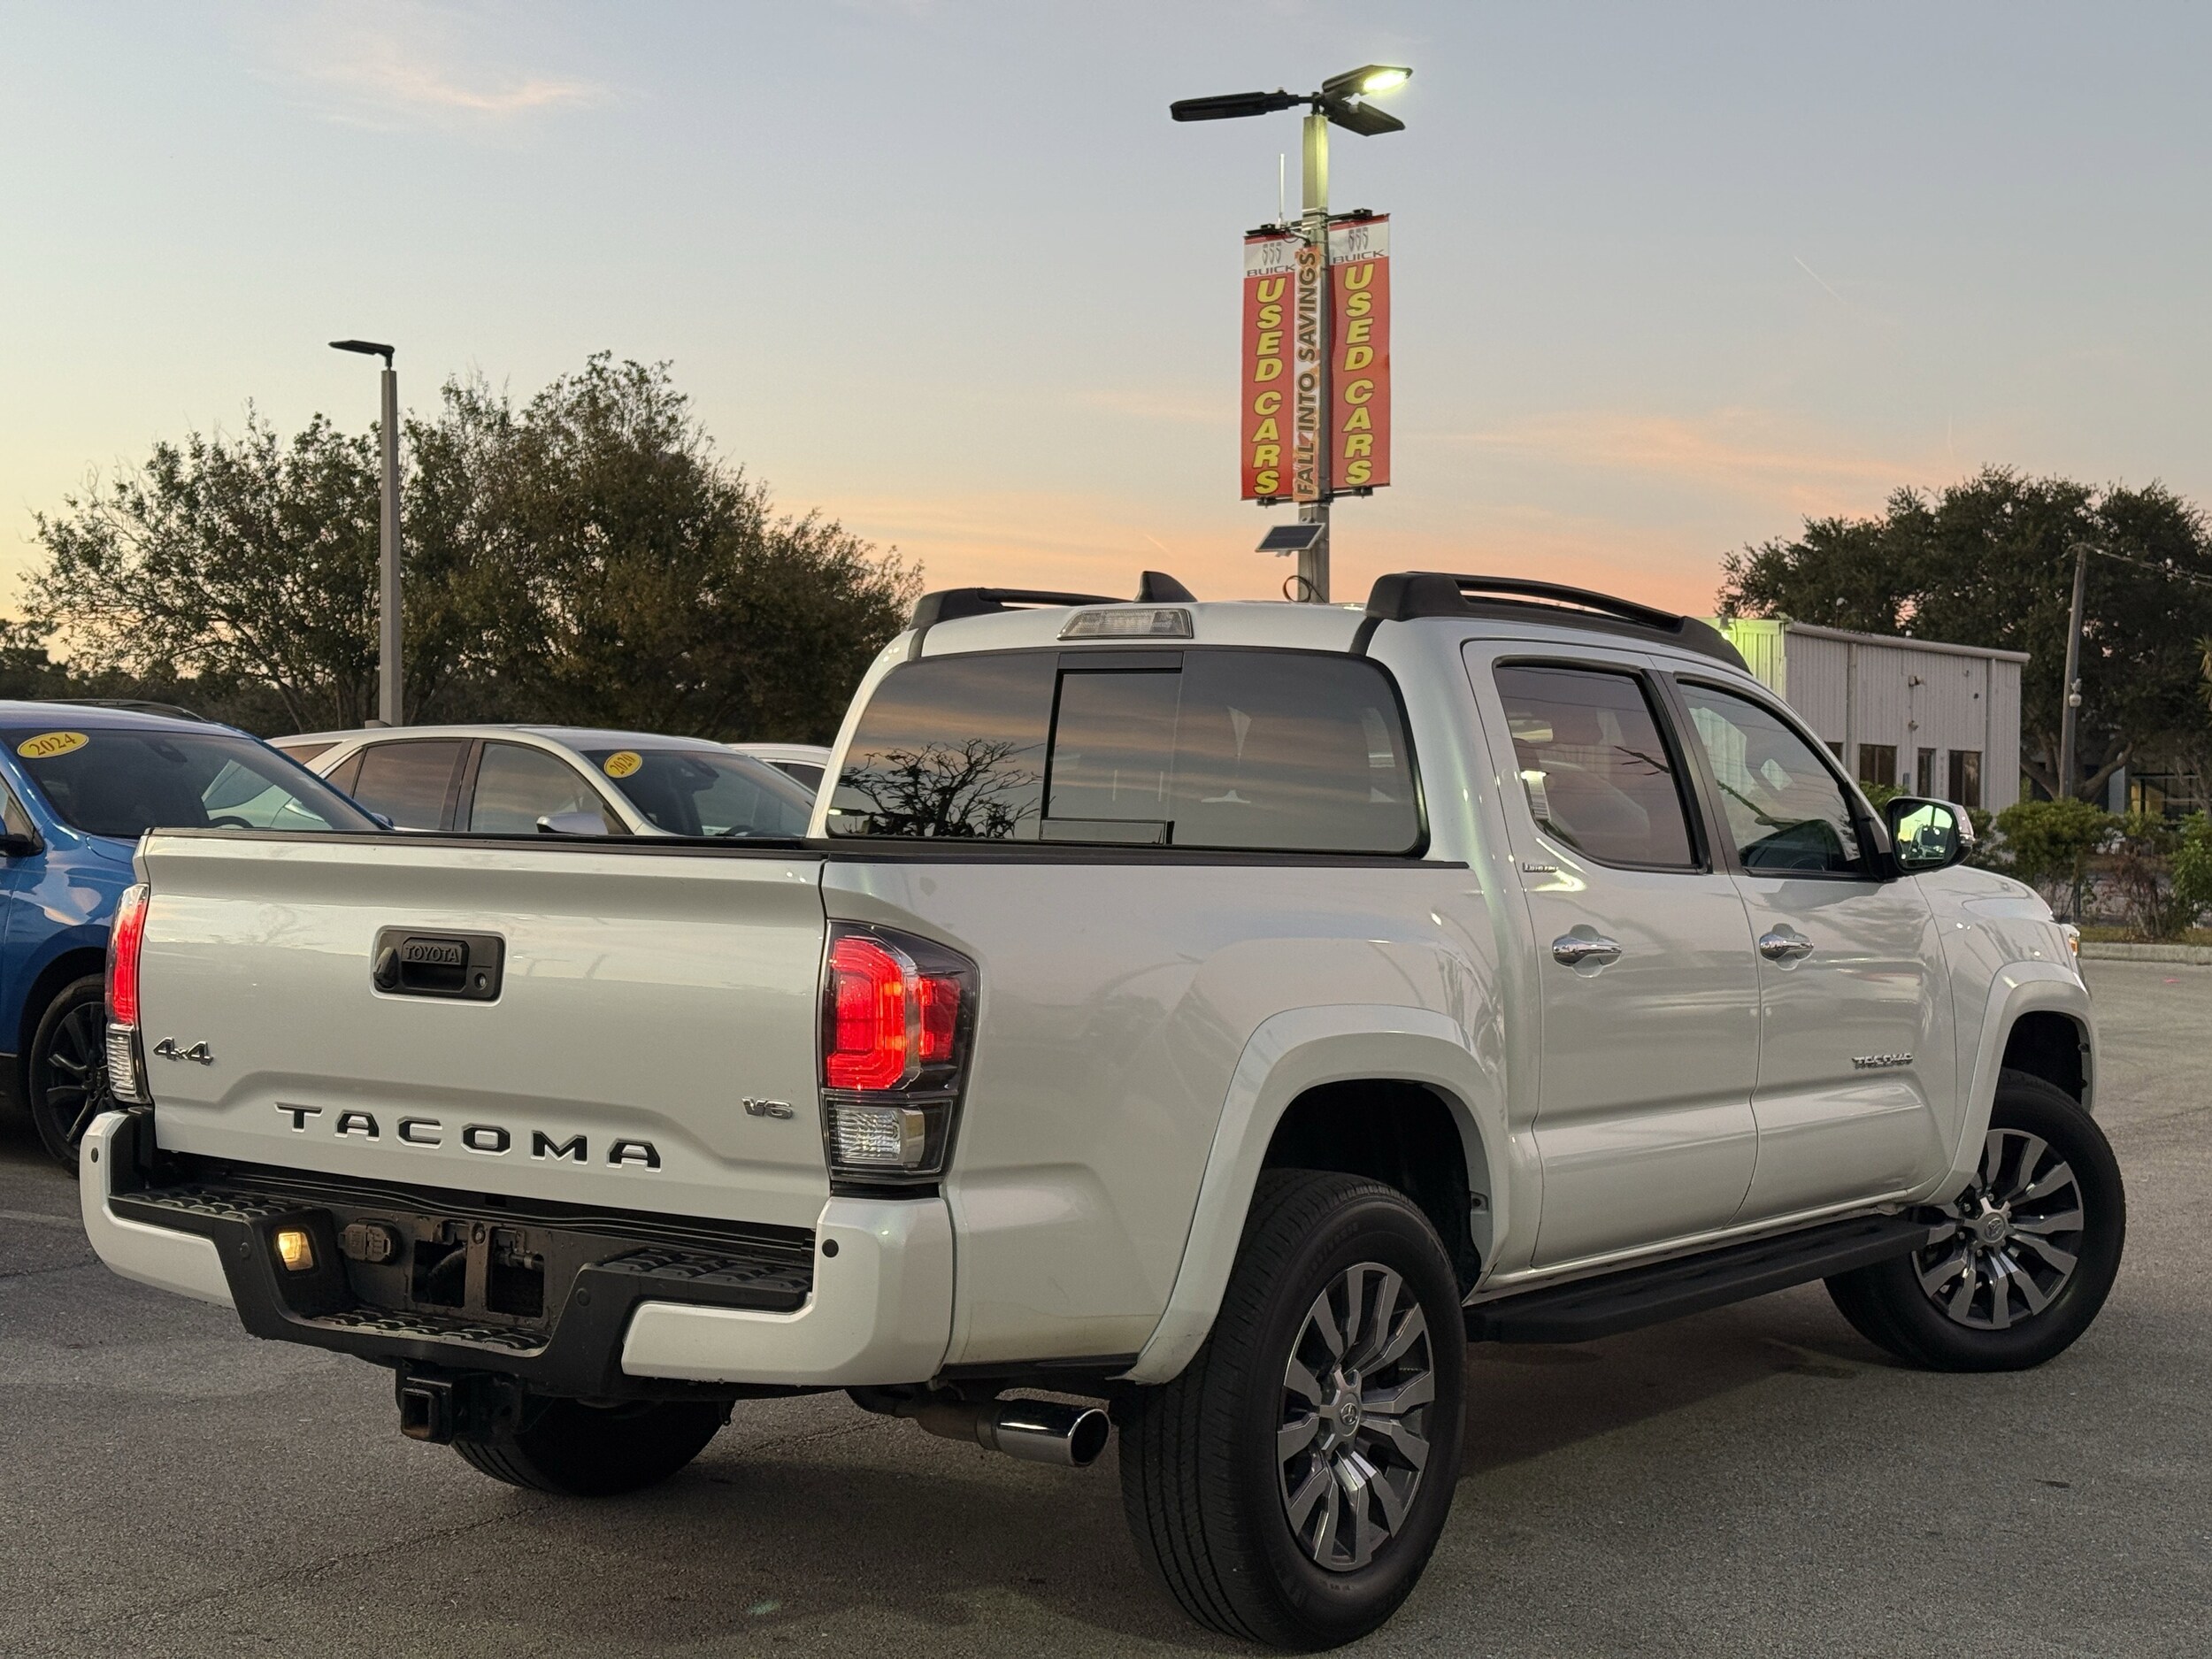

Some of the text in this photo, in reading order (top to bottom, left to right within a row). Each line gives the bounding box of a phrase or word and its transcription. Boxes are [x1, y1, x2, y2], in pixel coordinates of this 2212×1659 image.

[1333, 250, 1386, 265] BUICK
[1247, 264, 1295, 277] BUICK
[1297, 252, 1317, 495] FALL INTO SAVINGS
[1341, 262, 1374, 485] USED CARS
[1251, 277, 1286, 495] USED CARS
[29, 733, 76, 756] 2024
[610, 754, 635, 775] 2020
[406, 945, 460, 963] TOYOTA
[741, 1096, 795, 1119] V6
[274, 1102, 661, 1172] TACOMA
